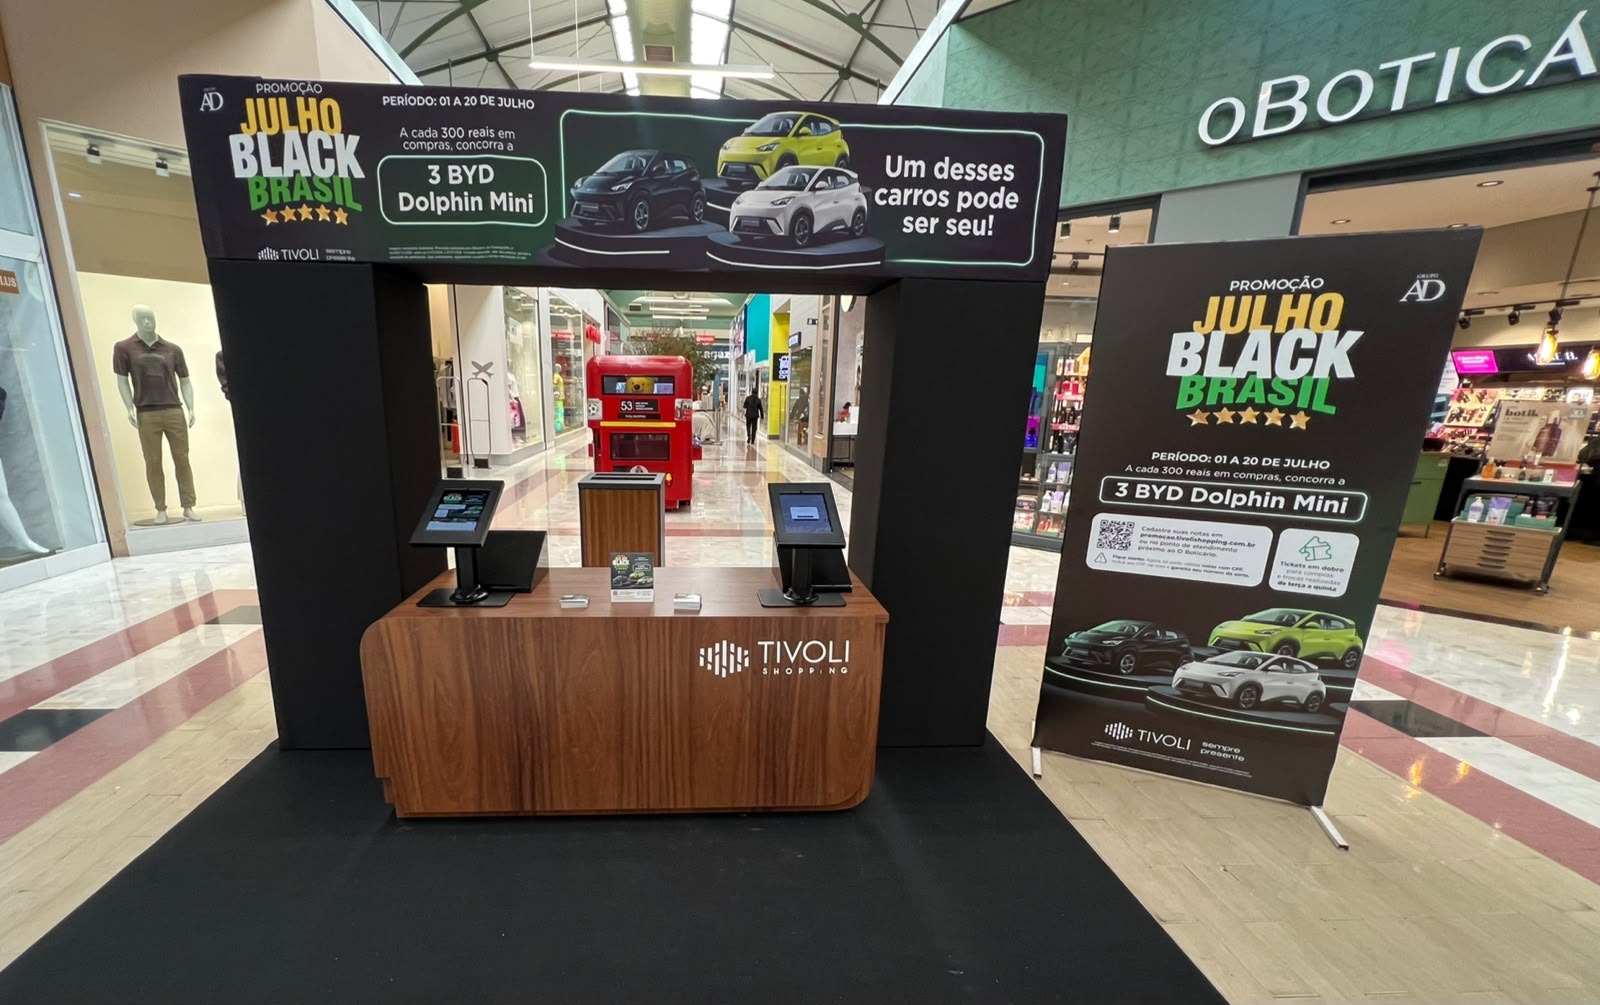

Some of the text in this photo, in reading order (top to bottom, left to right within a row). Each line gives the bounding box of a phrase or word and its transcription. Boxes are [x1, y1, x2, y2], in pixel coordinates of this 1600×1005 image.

[256, 82, 323, 95] PROMOÇÃO
[382, 94, 535, 110] PERÍODO: 01 A 20 DE JULHO
[240, 97, 342, 136] JULHO
[400, 126, 516, 139] A cada 300 reais em
[229, 130, 365, 178] BLACK
[403, 140, 514, 151] compras, concorra a
[427, 164, 494, 185] 3 BYD
[885, 155, 1015, 181] Um desses
[248, 174, 363, 212] BRASIL
[874, 186, 1019, 212] carros pode
[399, 191, 533, 215] Dolphin Mini
[902, 214, 994, 236] ser seu!
[280, 248, 319, 260] TIVOLI
[1229, 275, 1325, 292] PROMOÇÃO
[1398, 279, 1446, 302] AD
[1192, 292, 1345, 335] JULHO
[1165, 328, 1365, 380] BLACK
[1175, 374, 1337, 415] BRASIL
[620, 401, 633, 411] 53
[1151, 451, 1331, 470] PERÍODO: 01 A 20 DE JULHO
[1124, 464, 1346, 486] A cada 300 reais em compras, concorra a
[1114, 482, 1349, 515] 3 BYD Dolphin Mini
[1141, 525, 1171, 534] Cadastre
[1137, 545, 1166, 554] próximo
[1140, 532, 1256, 548] promocao.tivolishopping.com.br
[1160, 540, 1181, 548] ponto
[1192, 544, 1238, 553] atendimento
[1280, 561, 1306, 569] Tickets
[1321, 565, 1345, 573] dobro
[1288, 581, 1306, 589] terça
[1313, 584, 1337, 592] quinta
[757, 640, 850, 663] TIVOLI
[762, 666, 849, 675] SHOPPING
[1137, 729, 1192, 751] TIVOLI
[1202, 741, 1241, 754] sempre
[1200, 748, 1245, 762] presente
